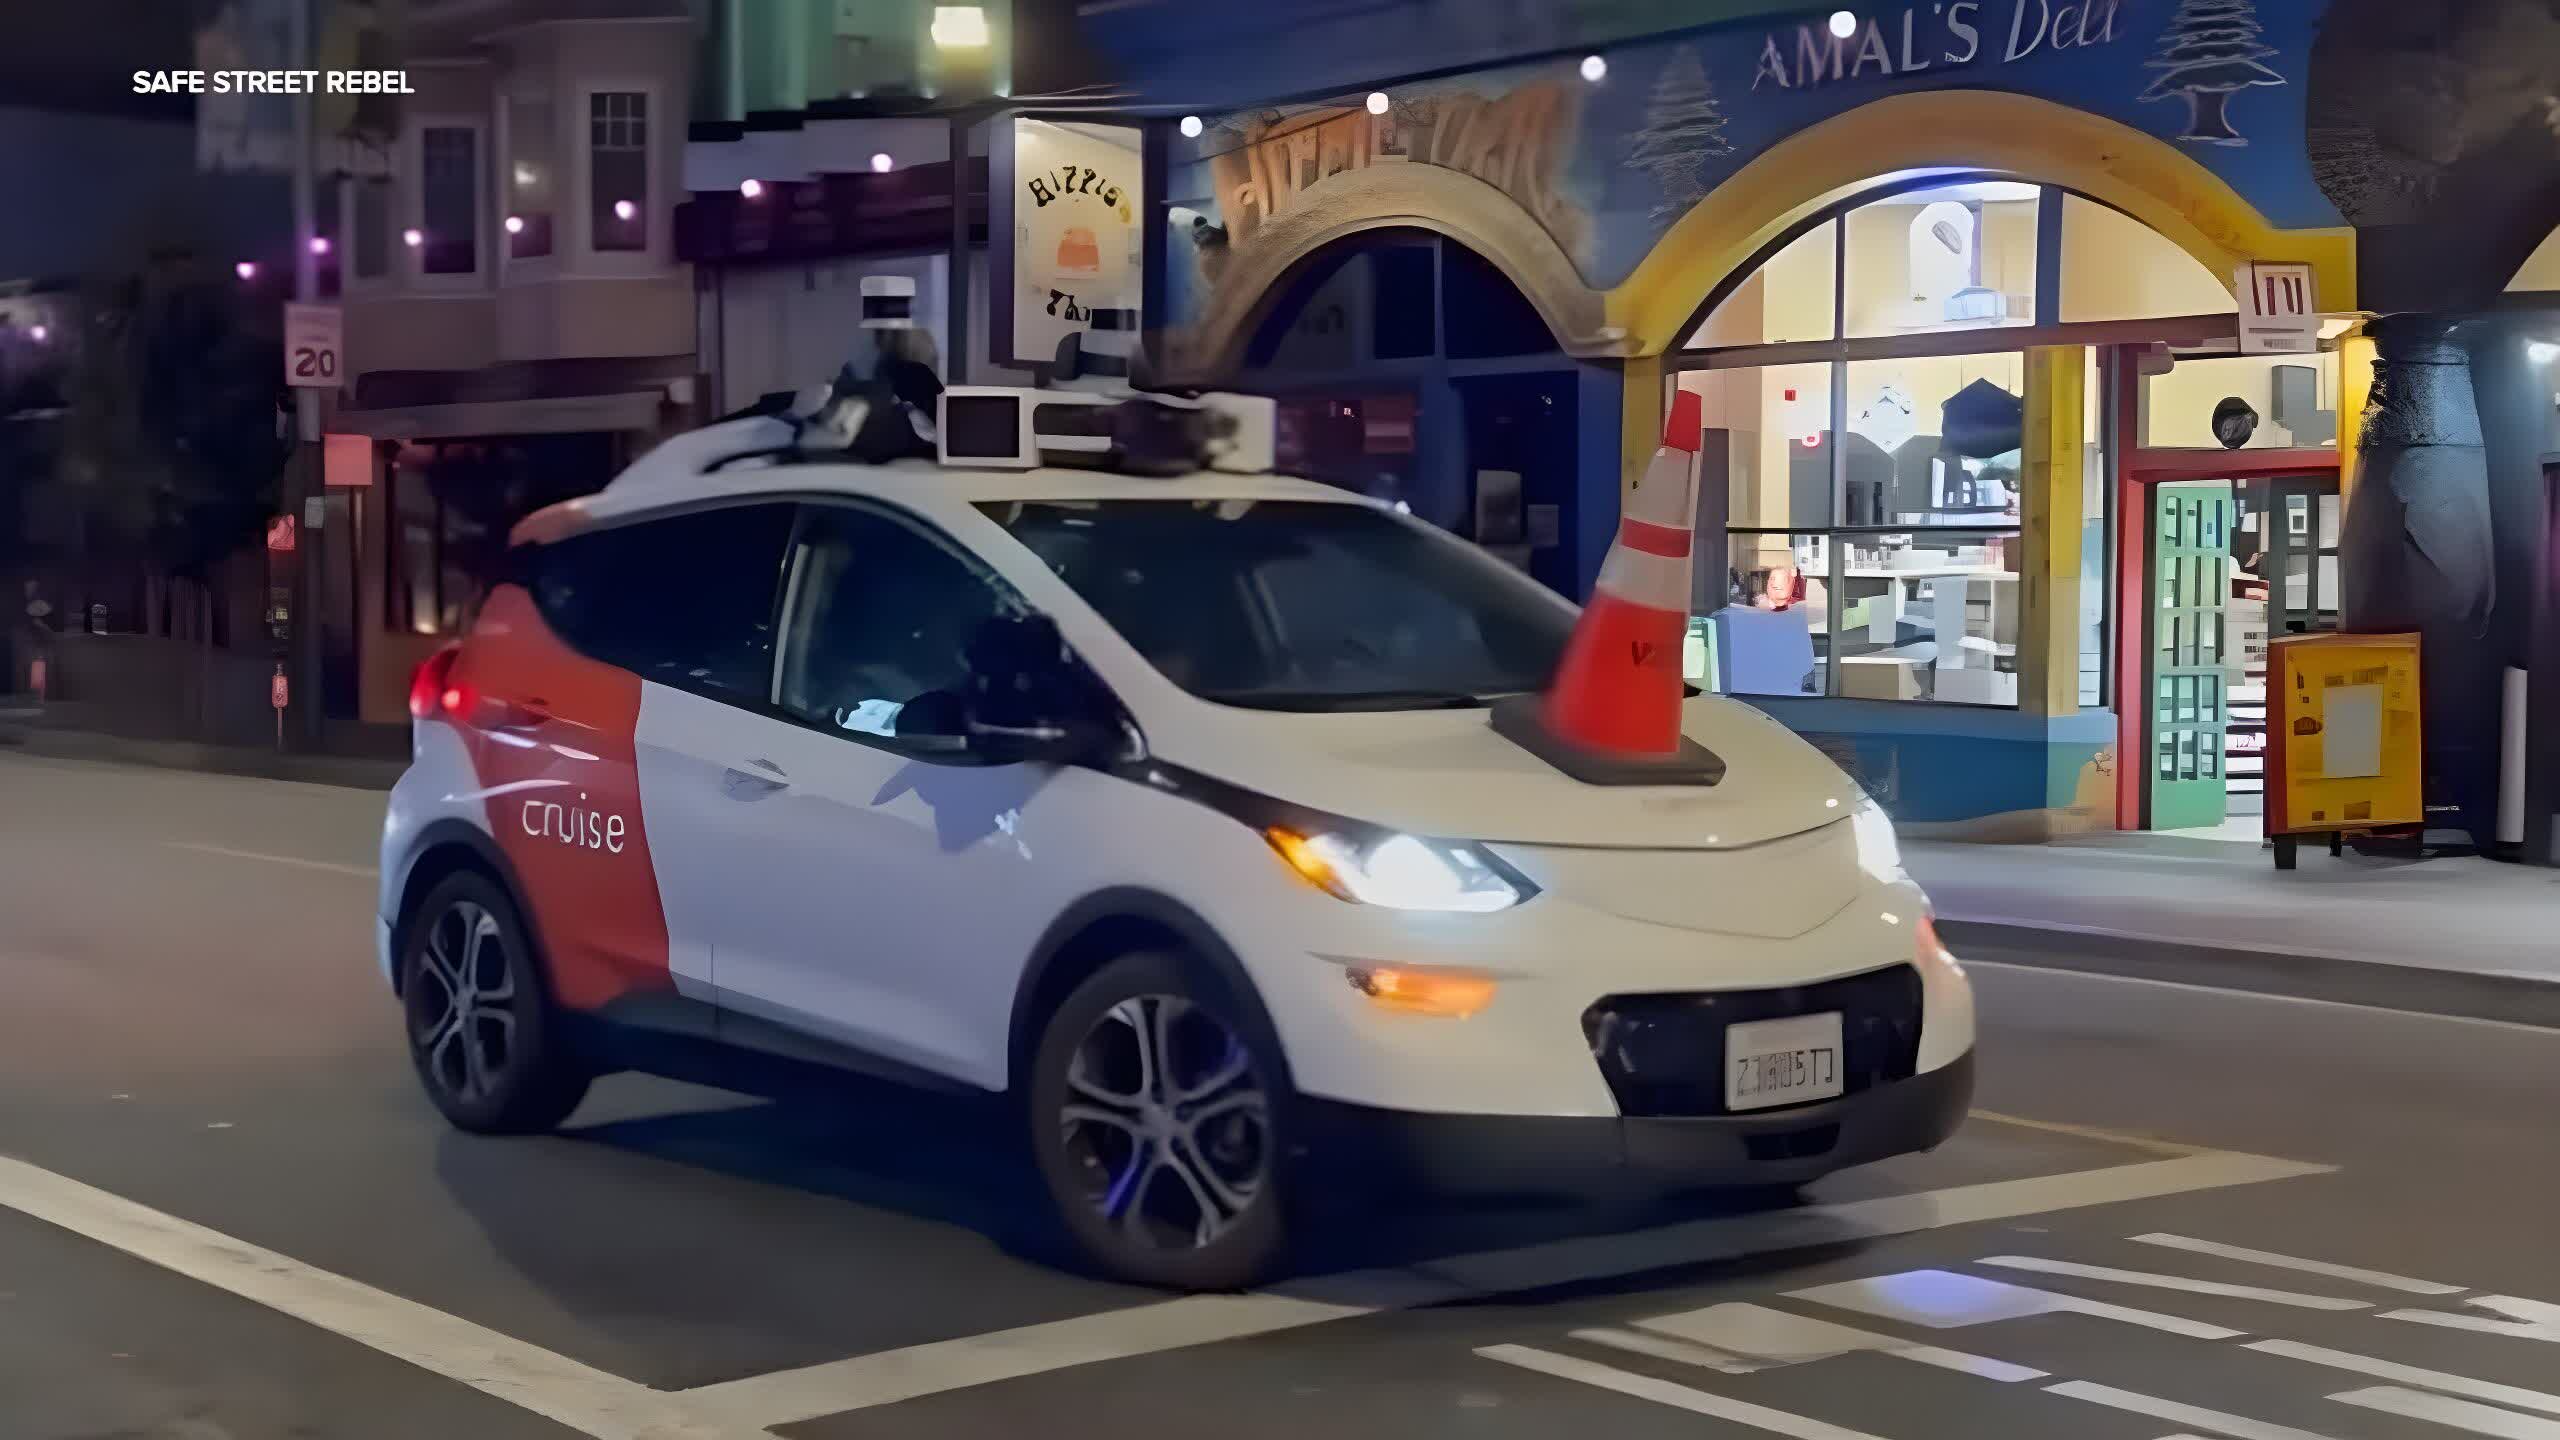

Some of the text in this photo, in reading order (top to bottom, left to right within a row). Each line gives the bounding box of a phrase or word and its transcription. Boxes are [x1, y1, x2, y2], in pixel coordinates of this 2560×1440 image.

[1752, 1, 1979, 91] AMAL'S
[295, 347, 336, 378] 20
[522, 792, 625, 853] cruise
